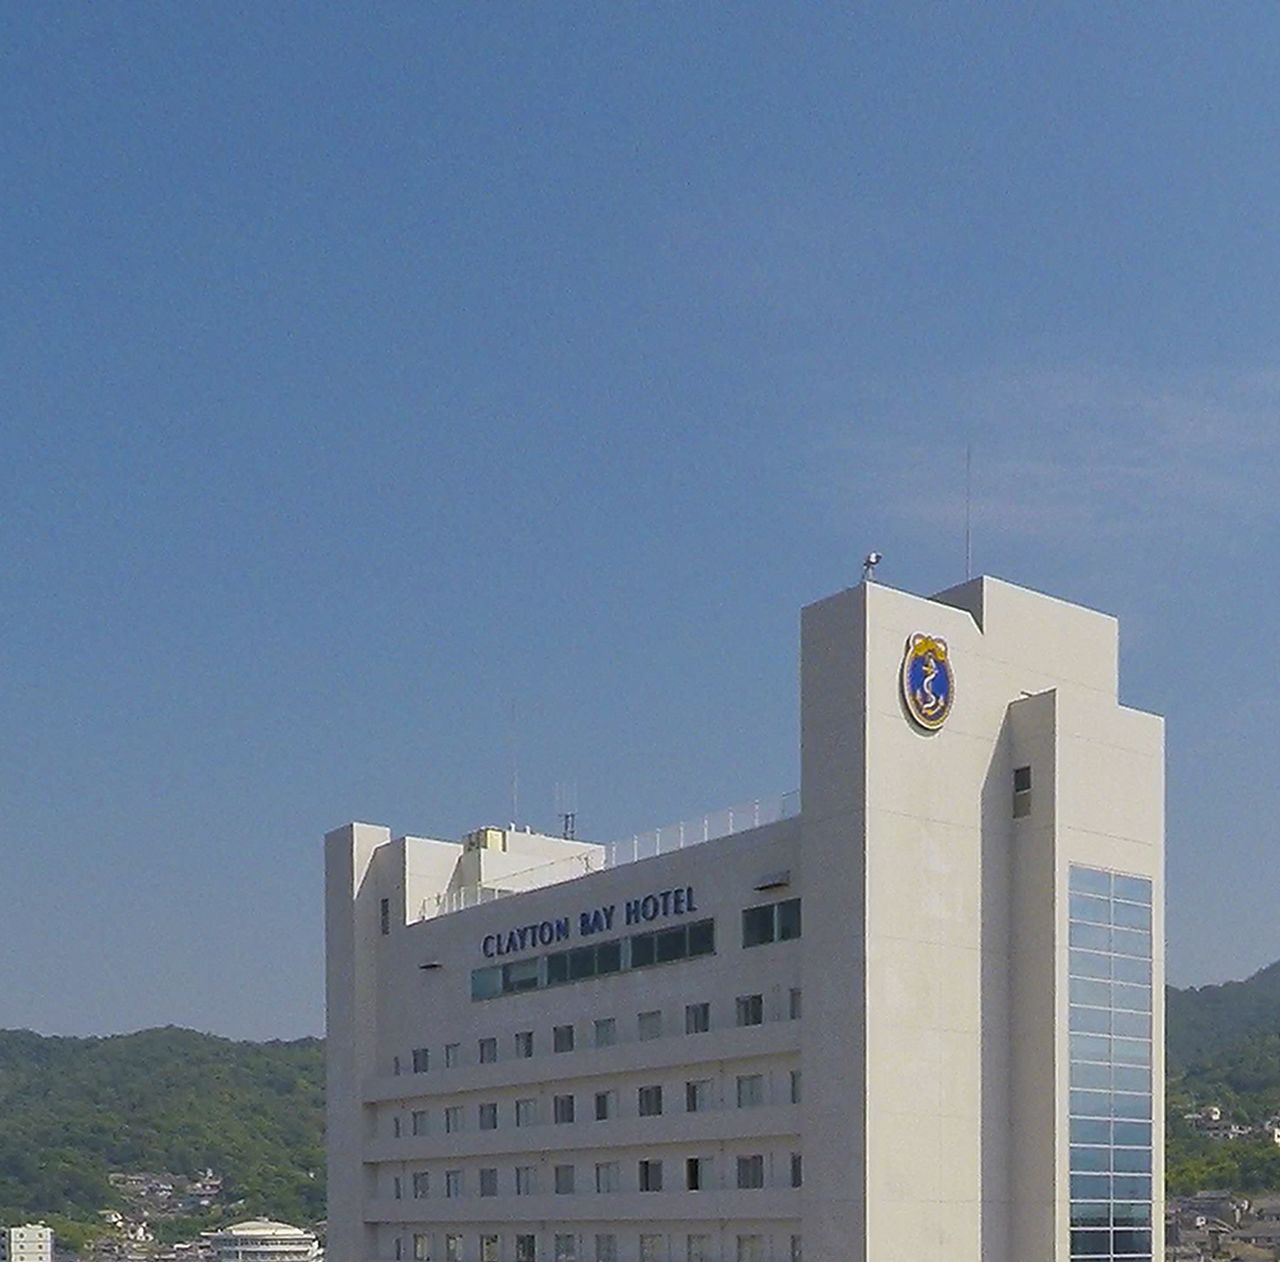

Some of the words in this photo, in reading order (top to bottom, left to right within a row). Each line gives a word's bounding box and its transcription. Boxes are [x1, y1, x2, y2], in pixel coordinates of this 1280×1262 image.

[482, 916, 570, 958] CLAYTON
[580, 905, 616, 936] BAY
[625, 886, 698, 926] HOTEL
